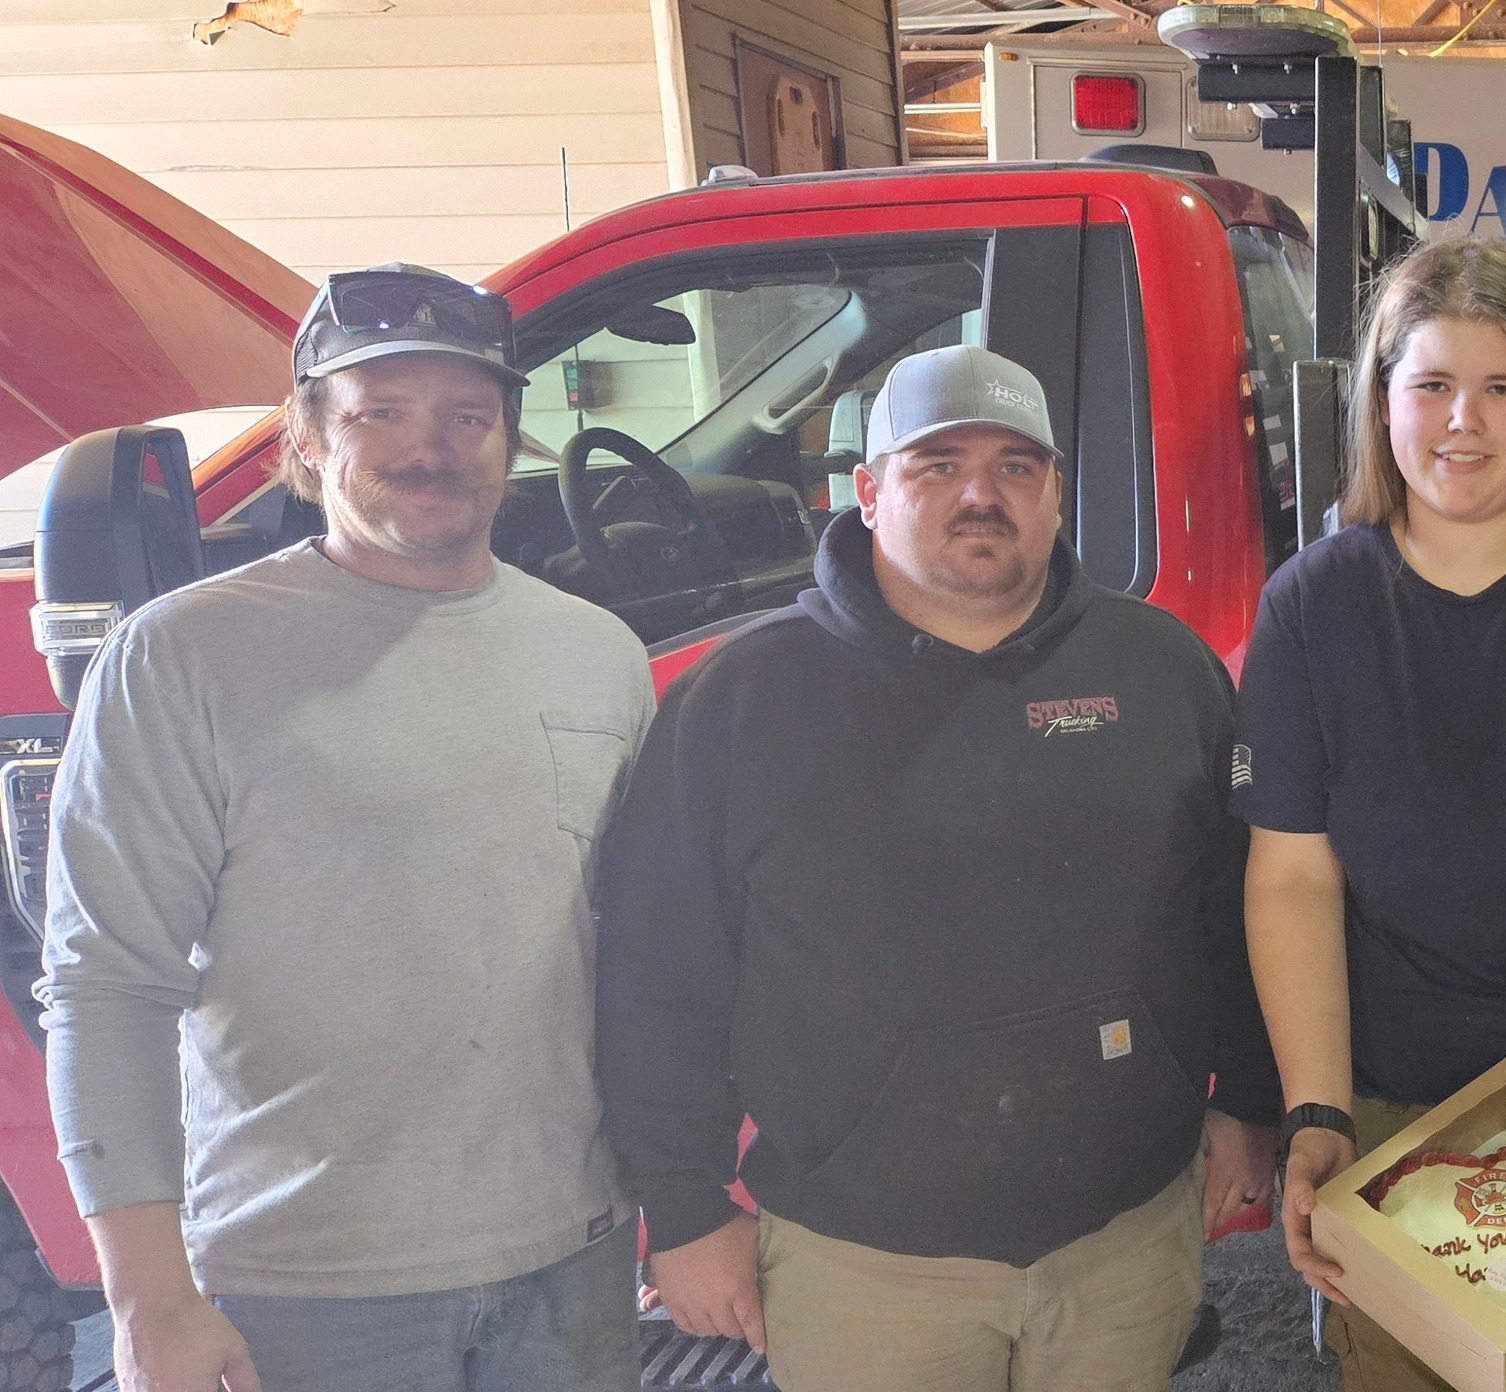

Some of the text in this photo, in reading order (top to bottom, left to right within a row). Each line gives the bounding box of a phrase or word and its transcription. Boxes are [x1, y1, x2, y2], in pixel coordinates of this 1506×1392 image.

[1026, 696, 1119, 729] STEVENS
[1044, 715, 1104, 738] Trucking
[1474, 1171, 1506, 1184] FIRE
